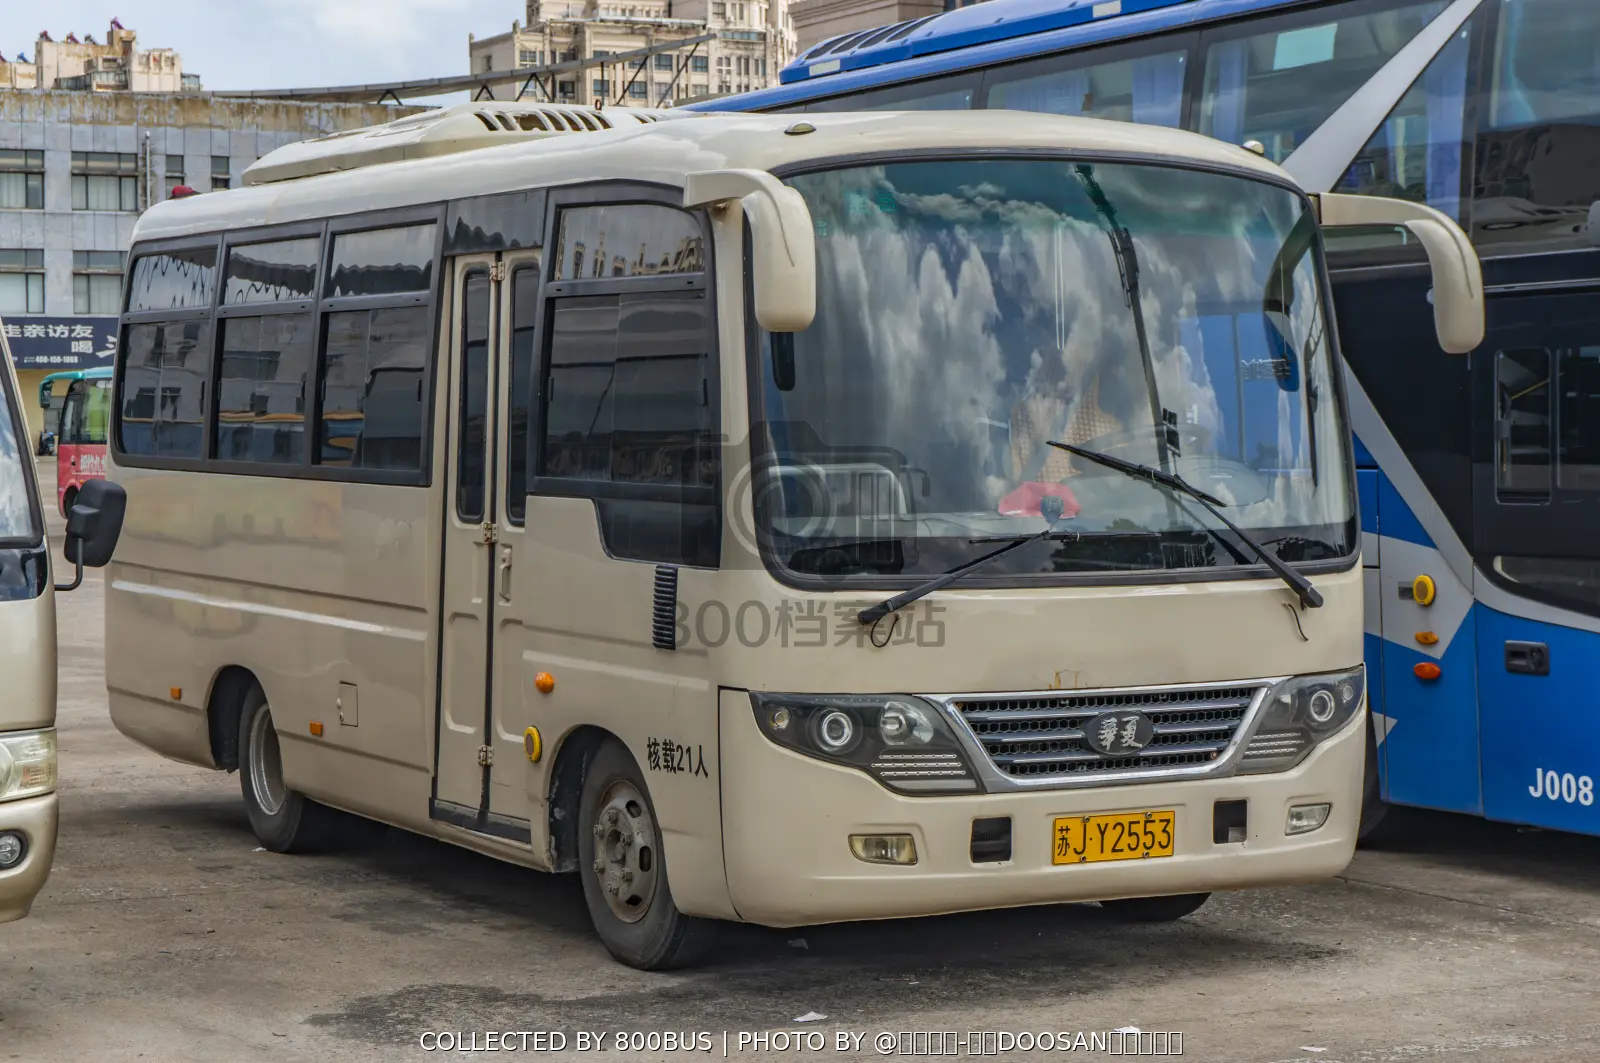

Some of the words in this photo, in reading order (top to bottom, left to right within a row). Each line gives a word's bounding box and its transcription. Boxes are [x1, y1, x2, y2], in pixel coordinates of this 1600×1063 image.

[71, 340, 93, 353] 喝
[647, 737, 709, 779] 核载21人
[1528, 768, 1594, 806] J008
